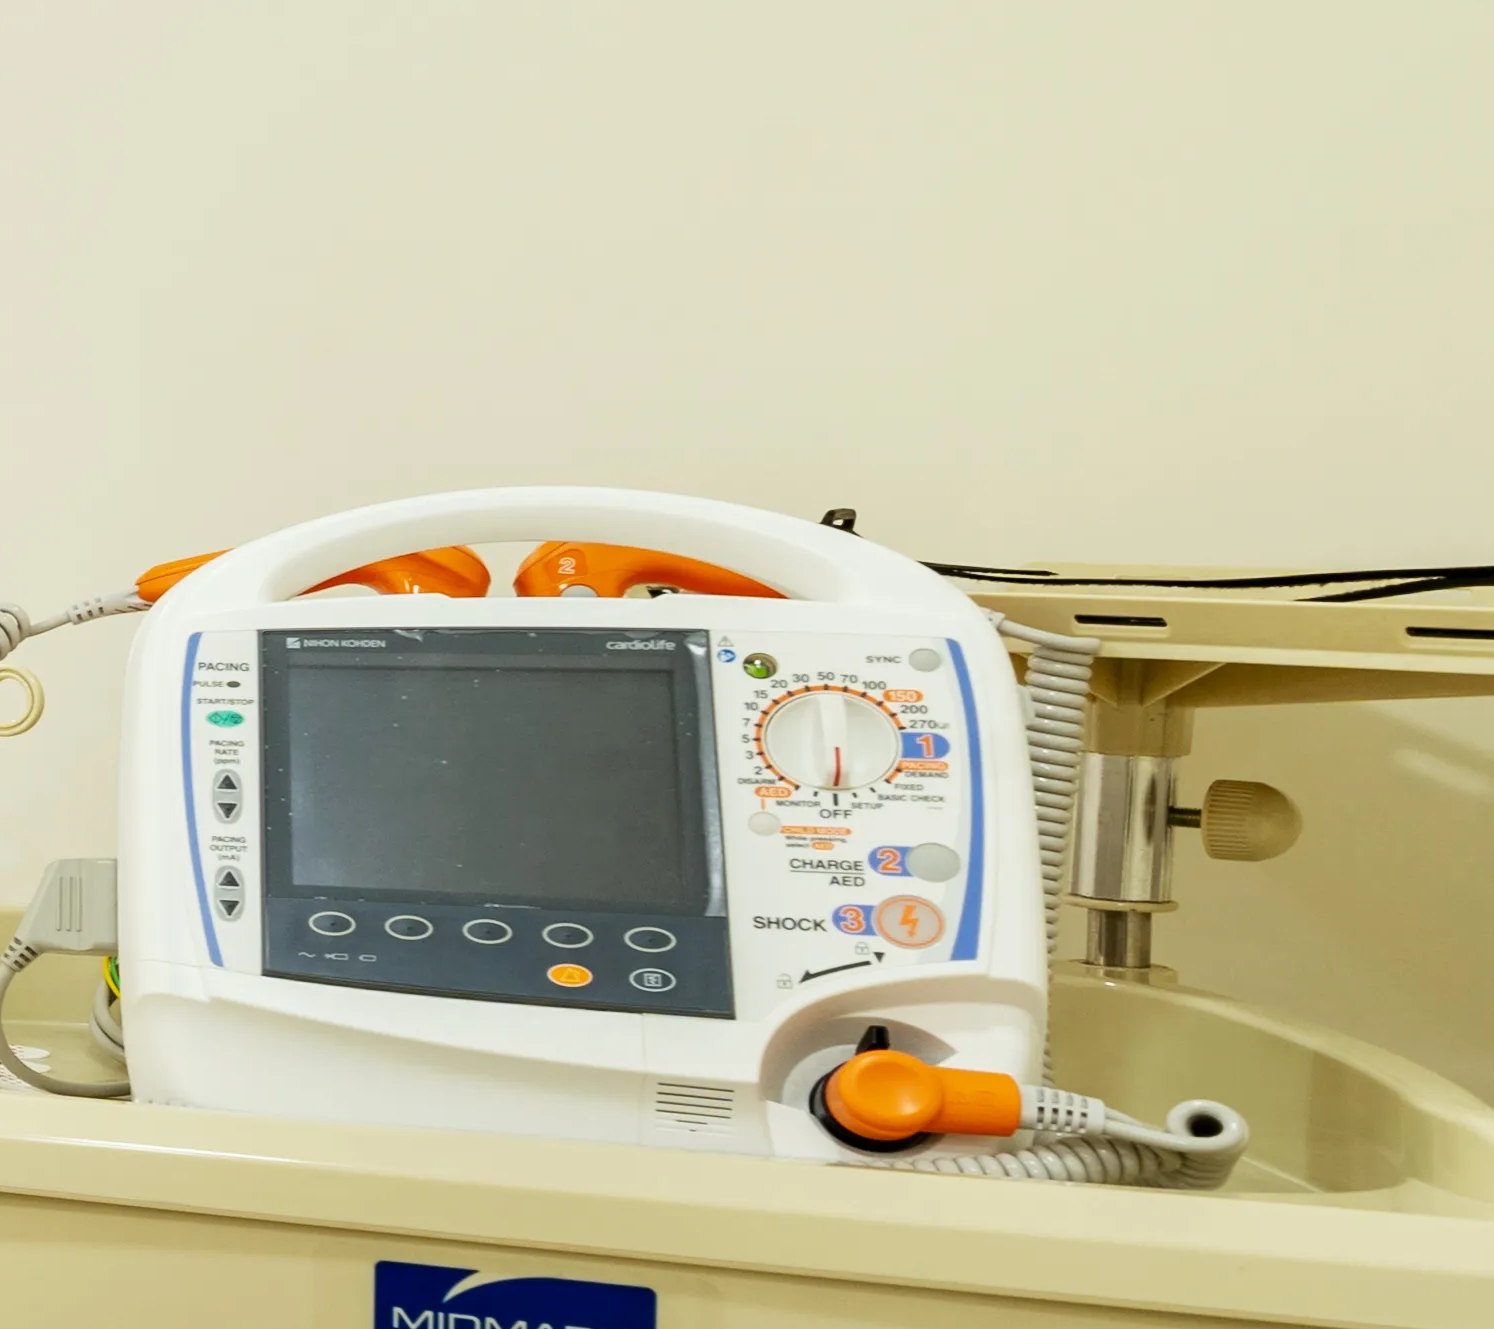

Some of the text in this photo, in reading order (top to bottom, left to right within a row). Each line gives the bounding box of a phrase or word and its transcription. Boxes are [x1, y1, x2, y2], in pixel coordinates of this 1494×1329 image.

[557, 557, 576, 574] 2
[303, 639, 386, 648] NIHON KOHDEN
[605, 639, 676, 650] cardiolife
[865, 655, 902, 664] SYNC
[198, 662, 250, 672] PACING
[792, 674, 810, 683] 30
[817, 671, 835, 681] 50
[840, 674, 859, 684] 70
[192, 680, 224, 688] PULSE
[770, 679, 788, 689] 20
[862, 681, 887, 690] 100
[753, 690, 768, 699] 15
[889, 692, 918, 702] 150
[196, 698, 255, 706] START/STOP
[744, 702, 758, 711] 10
[900, 704, 928, 714] 200
[742, 718, 751, 727] 7
[209, 739, 245, 747] PACING
[741, 734, 751, 744] 5
[916, 733, 934, 758] 1
[745, 750, 755, 760] 3
[754, 766, 763, 775] 2
[737, 777, 777, 785] DISARM
[894, 783, 924, 791] FIXED
[762, 788, 787, 797] AED
[877, 794, 945, 803] BASIC CHECK
[776, 800, 821, 808] MONITOR
[851, 802, 884, 810] SETUP
[819, 808, 853, 819] OFF
[212, 836, 246, 844] PACING
[789, 858, 864, 872] CHARGE
[877, 848, 902, 874] 2
[829, 875, 866, 888] AED
[753, 915, 828, 932] SHOCK
[840, 906, 865, 933] 3
